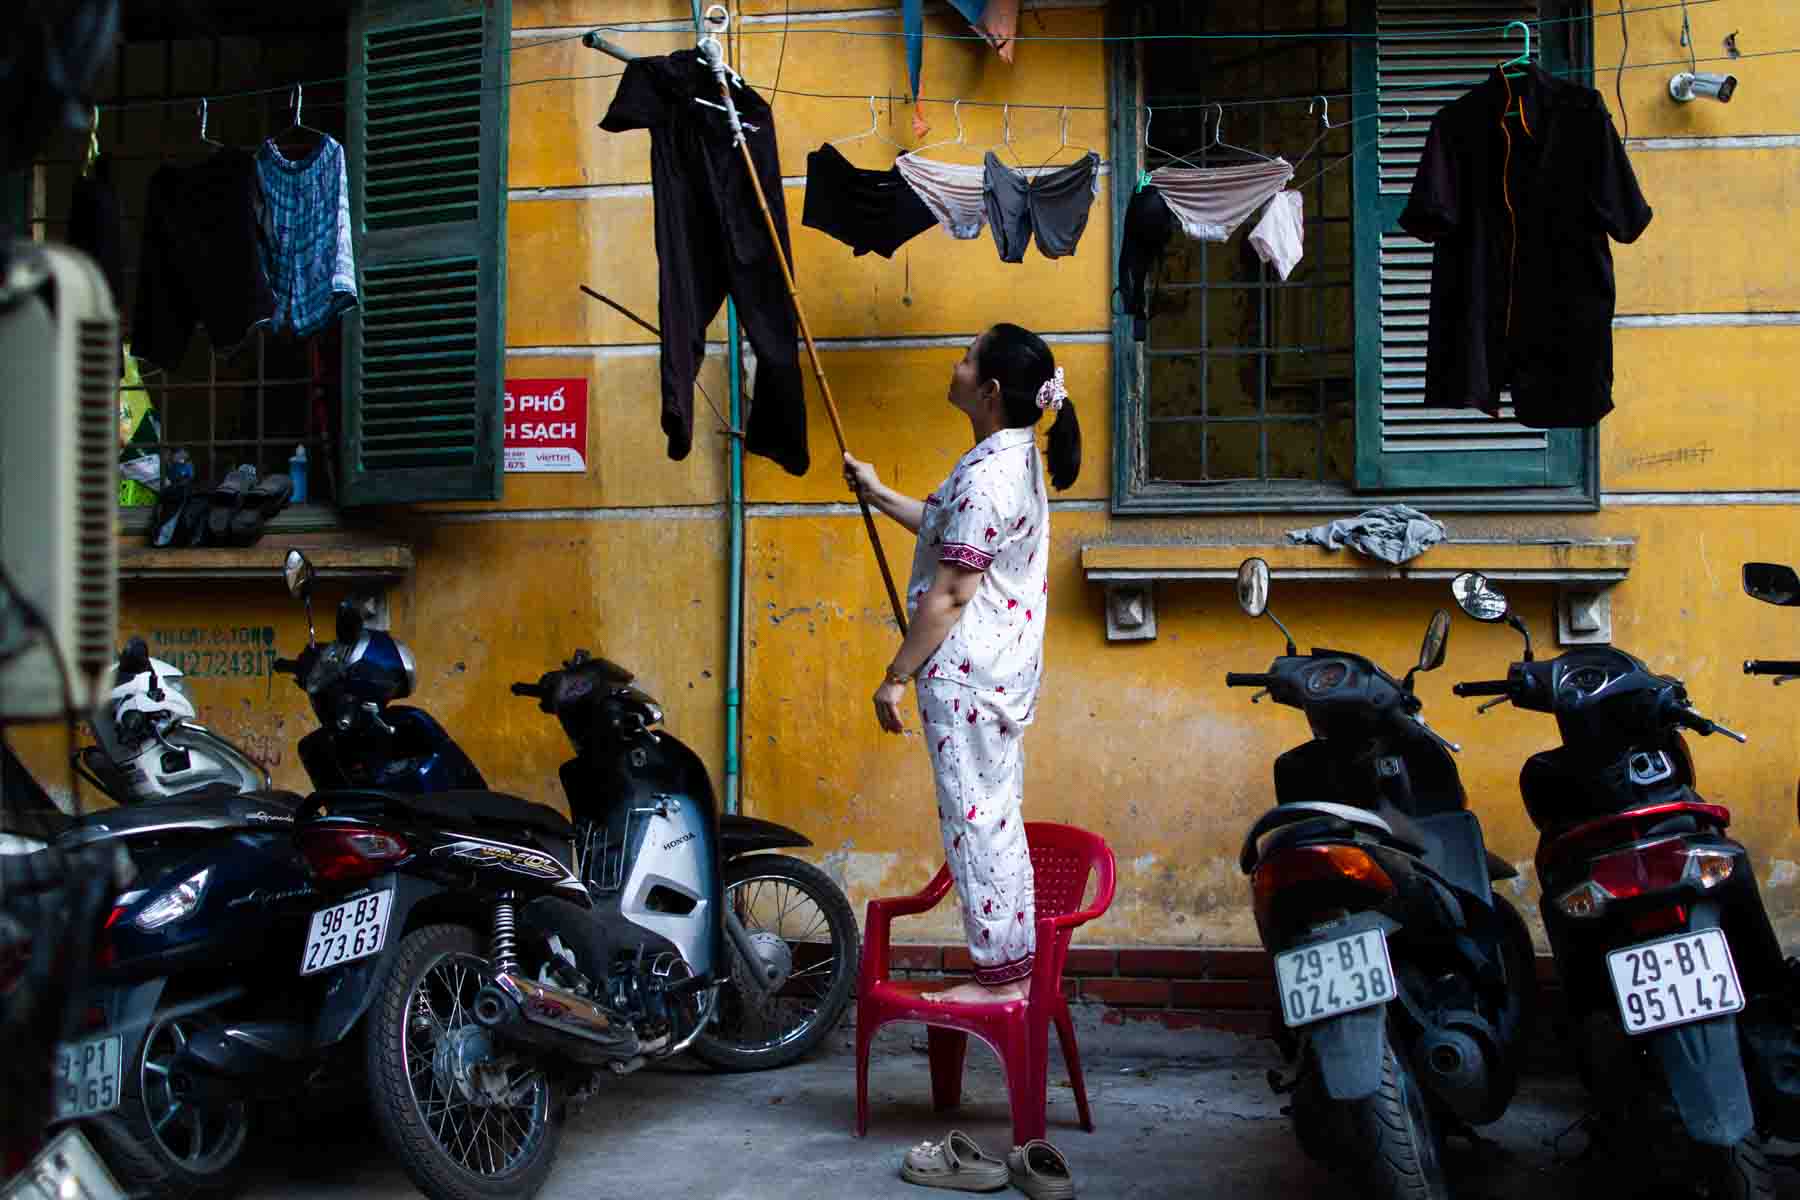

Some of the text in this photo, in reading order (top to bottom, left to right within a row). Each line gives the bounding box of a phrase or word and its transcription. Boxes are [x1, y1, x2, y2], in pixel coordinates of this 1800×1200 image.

[519, 386, 565, 412] PHỐ
[520, 422, 577, 442] SẠCH
[663, 832, 696, 850] HONDA
[320, 896, 379, 936] 98-B3
[307, 924, 380, 970] 273.63
[1293, 936, 1368, 984] 29-B1
[1625, 938, 1710, 986] 29-B1
[1289, 967, 1386, 1019] 024.38
[1627, 974, 1734, 1025] 951.42
